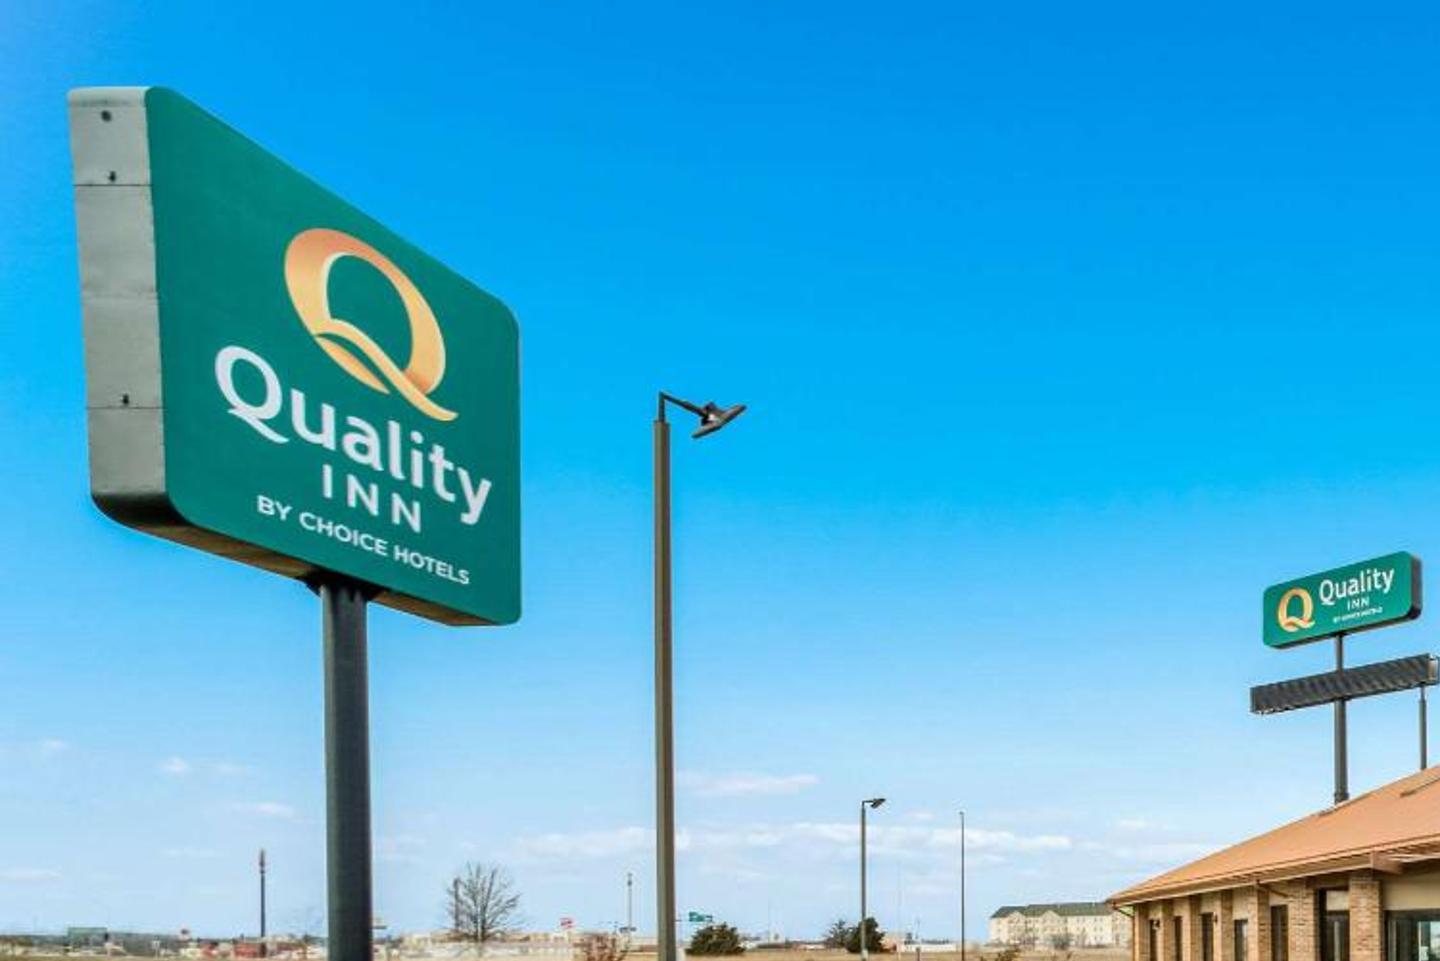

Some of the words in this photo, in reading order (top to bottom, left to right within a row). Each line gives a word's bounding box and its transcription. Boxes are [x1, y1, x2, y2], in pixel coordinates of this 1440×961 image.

[284, 228, 458, 421] Q
[214, 346, 492, 525] Quality
[322, 465, 422, 532] INN
[257, 495, 292, 521] BY
[300, 512, 388, 556] CHOICE
[394, 545, 470, 585] HOTELS
[1319, 568, 1395, 605] Quality
[1347, 597, 1370, 611] INN
